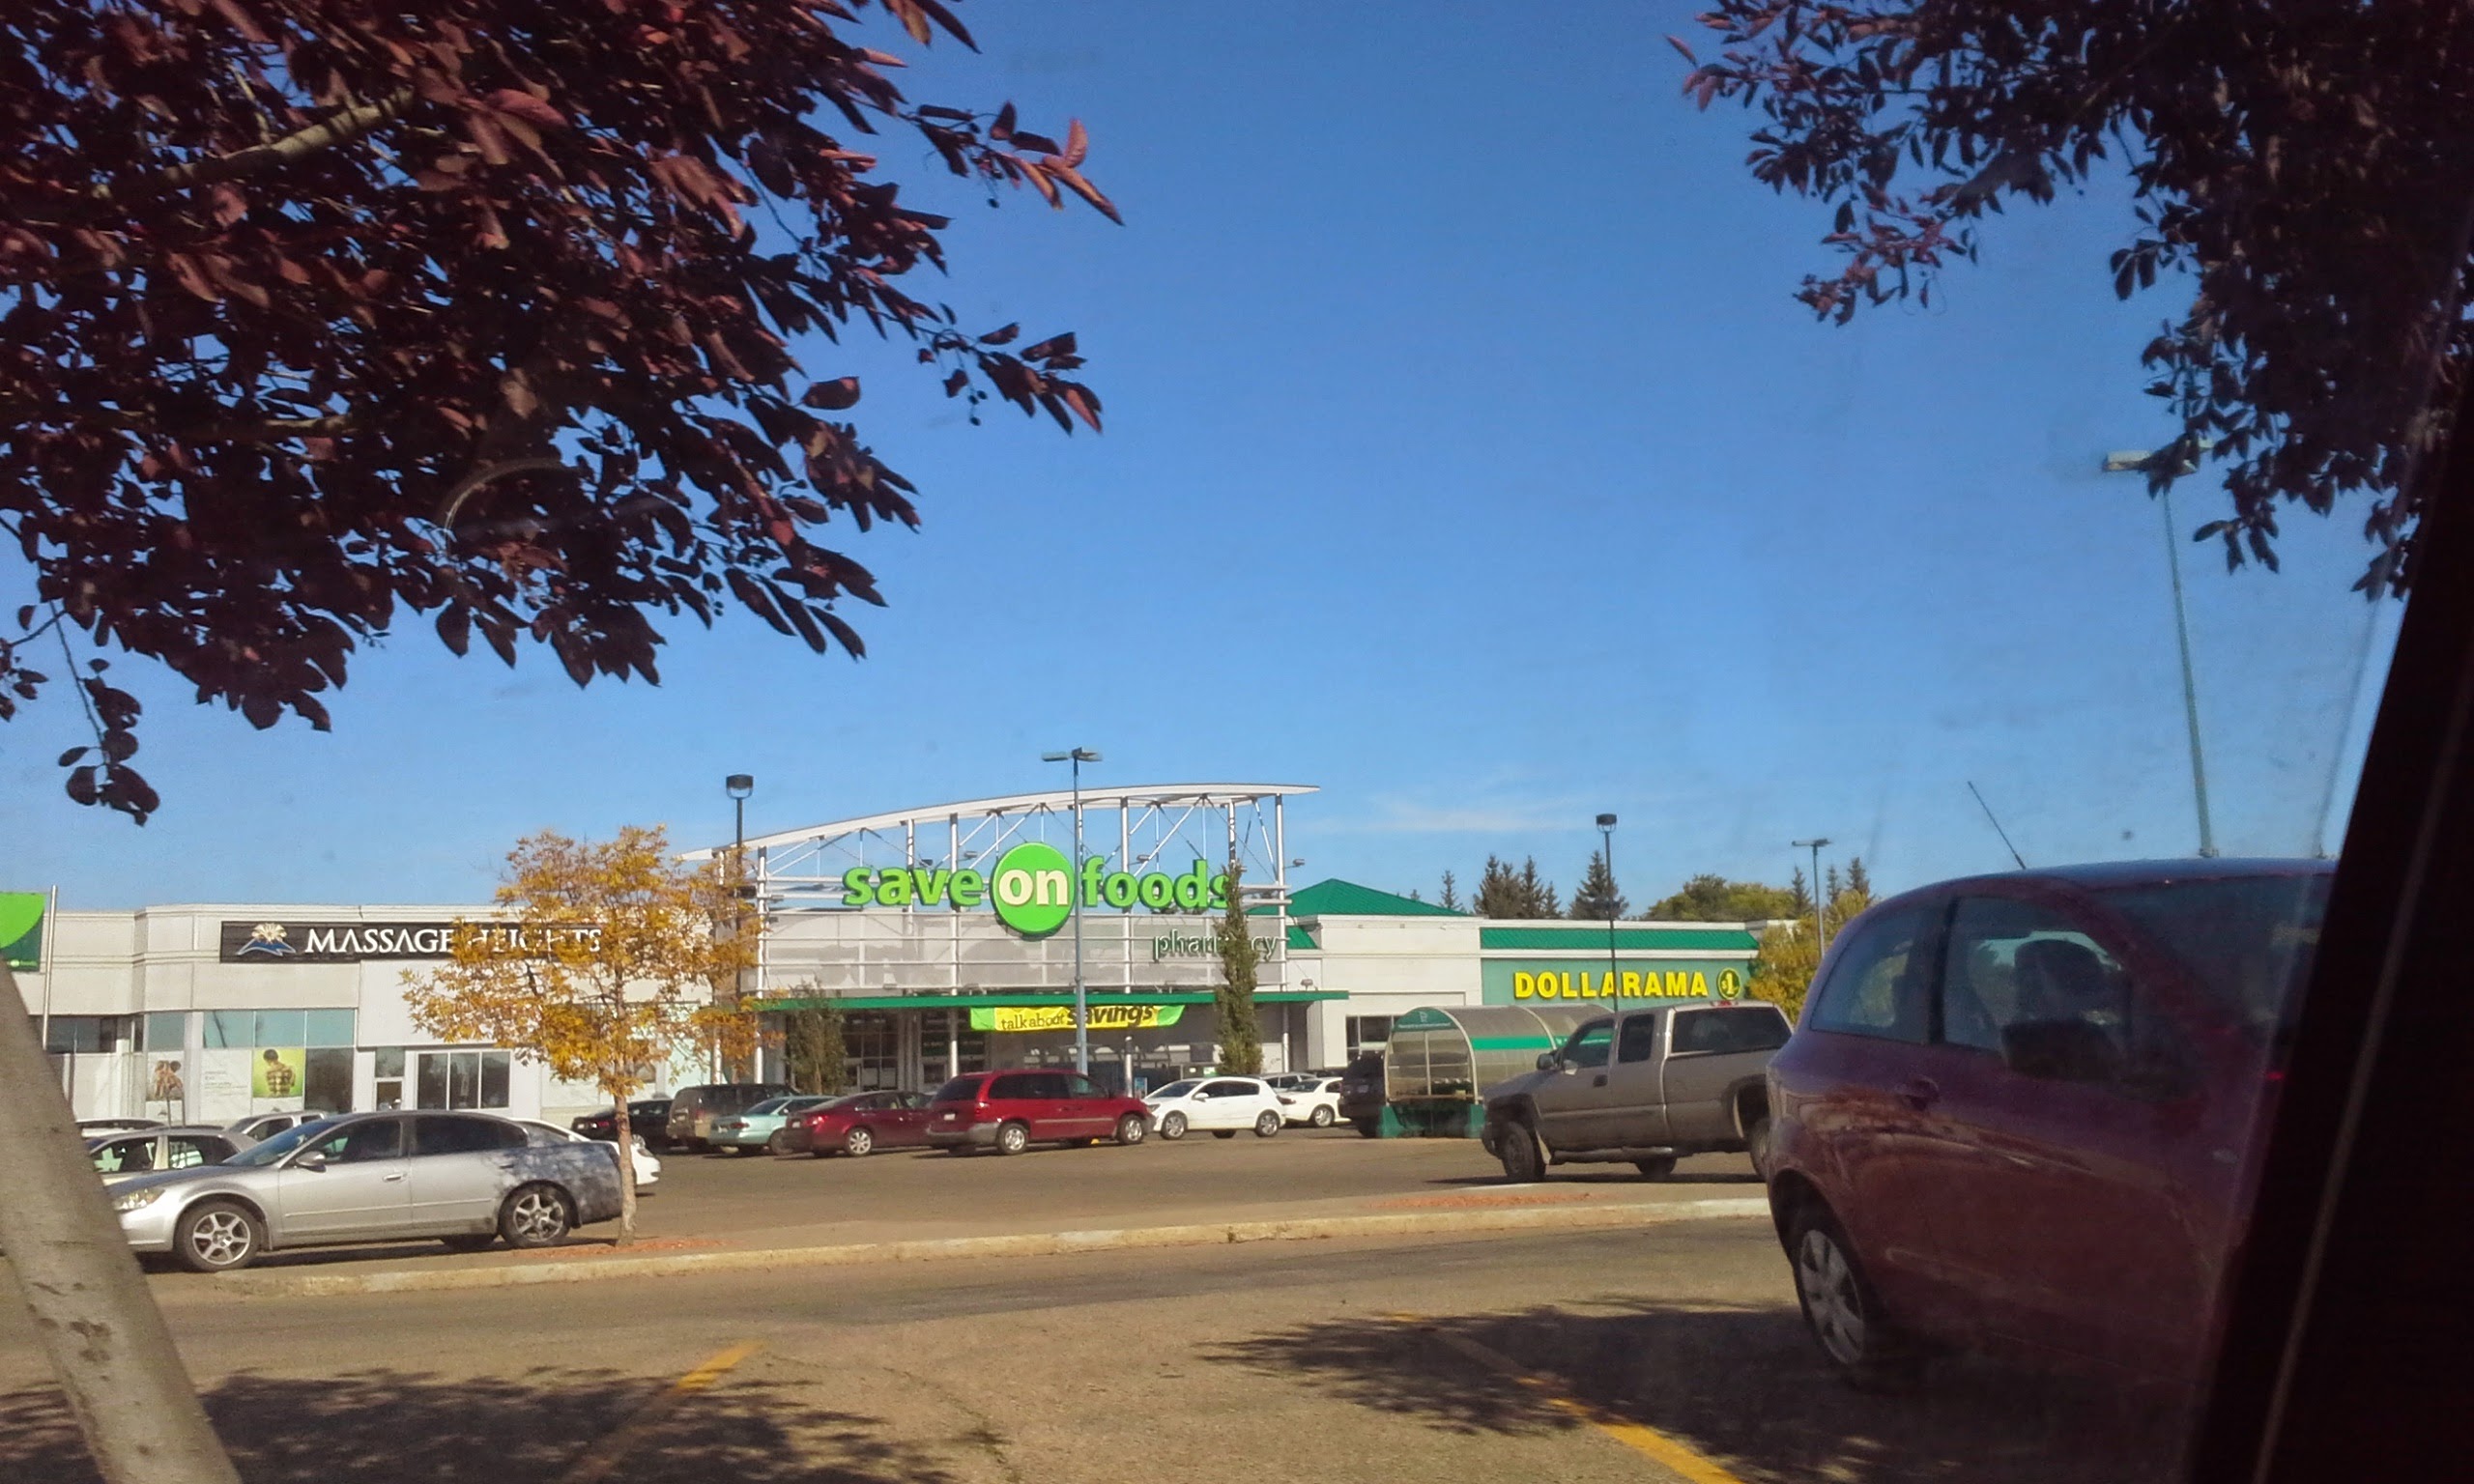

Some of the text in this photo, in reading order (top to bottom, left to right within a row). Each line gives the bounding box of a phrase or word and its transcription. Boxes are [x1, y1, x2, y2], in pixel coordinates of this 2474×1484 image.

[843, 856, 1231, 909] save on foods
[304, 928, 458, 954] MASSAGE
[1153, 928, 1277, 960] pharcy
[1514, 971, 1709, 999] DOLLARAMA
[1001, 1013, 1027, 1030] talk
[1028, 1013, 1064, 1029] about
